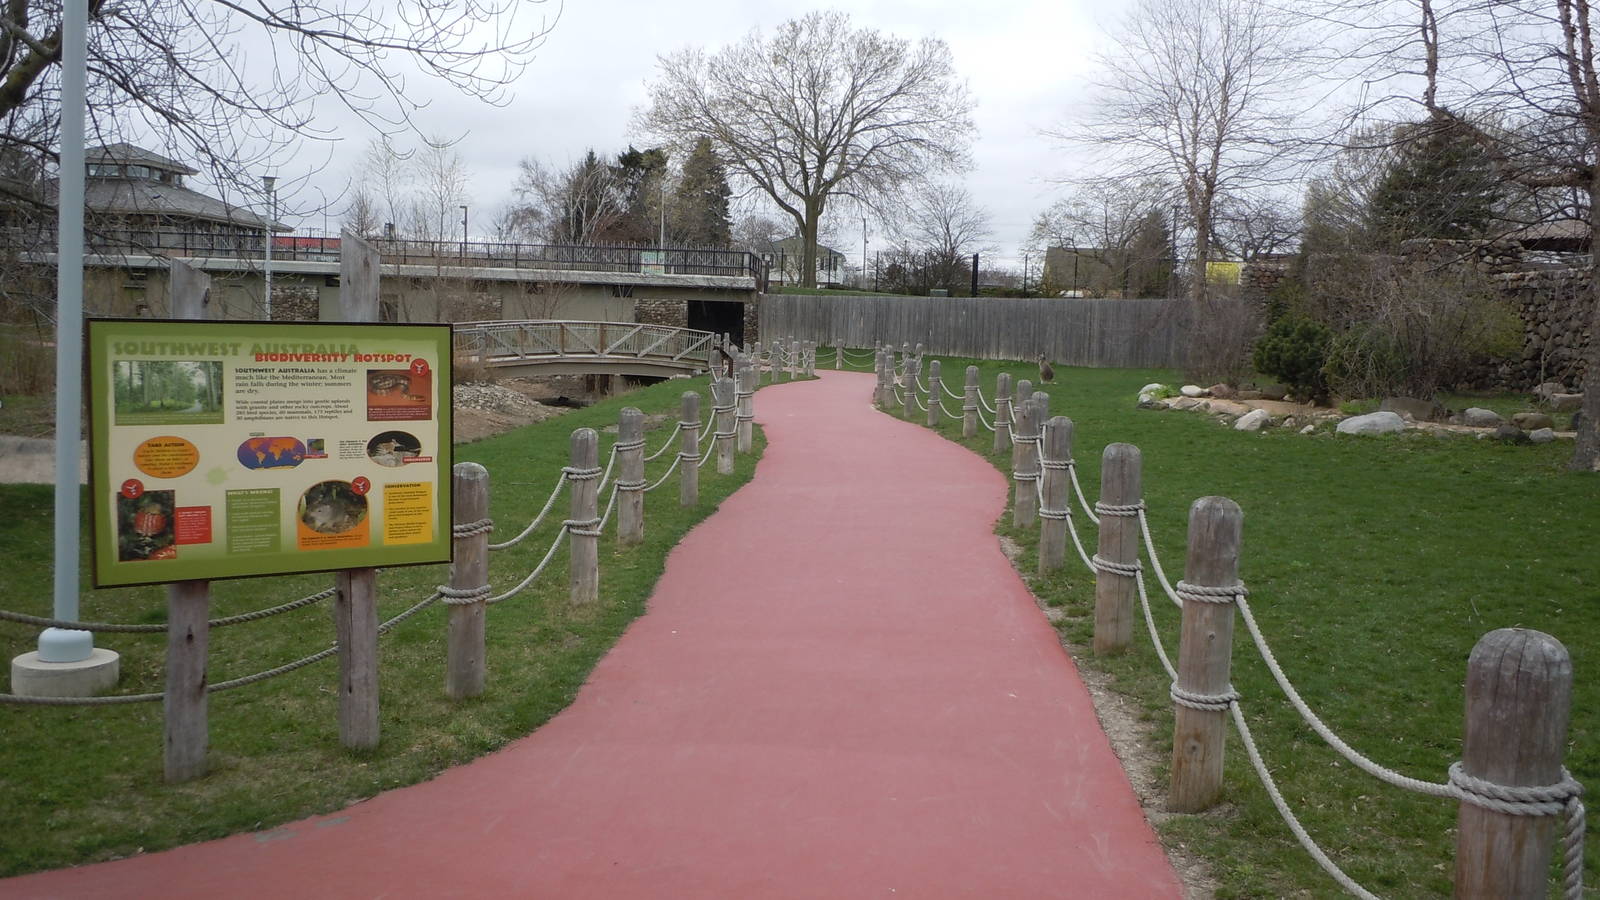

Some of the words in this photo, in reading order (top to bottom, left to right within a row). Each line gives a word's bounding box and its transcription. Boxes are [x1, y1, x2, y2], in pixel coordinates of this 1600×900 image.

[112, 341, 242, 356] SOUTHWEST
[248, 342, 360, 356] AUSTRALIA
[254, 352, 348, 363] BIODIVERSITY
[353, 353, 412, 363] HOTSPOT
